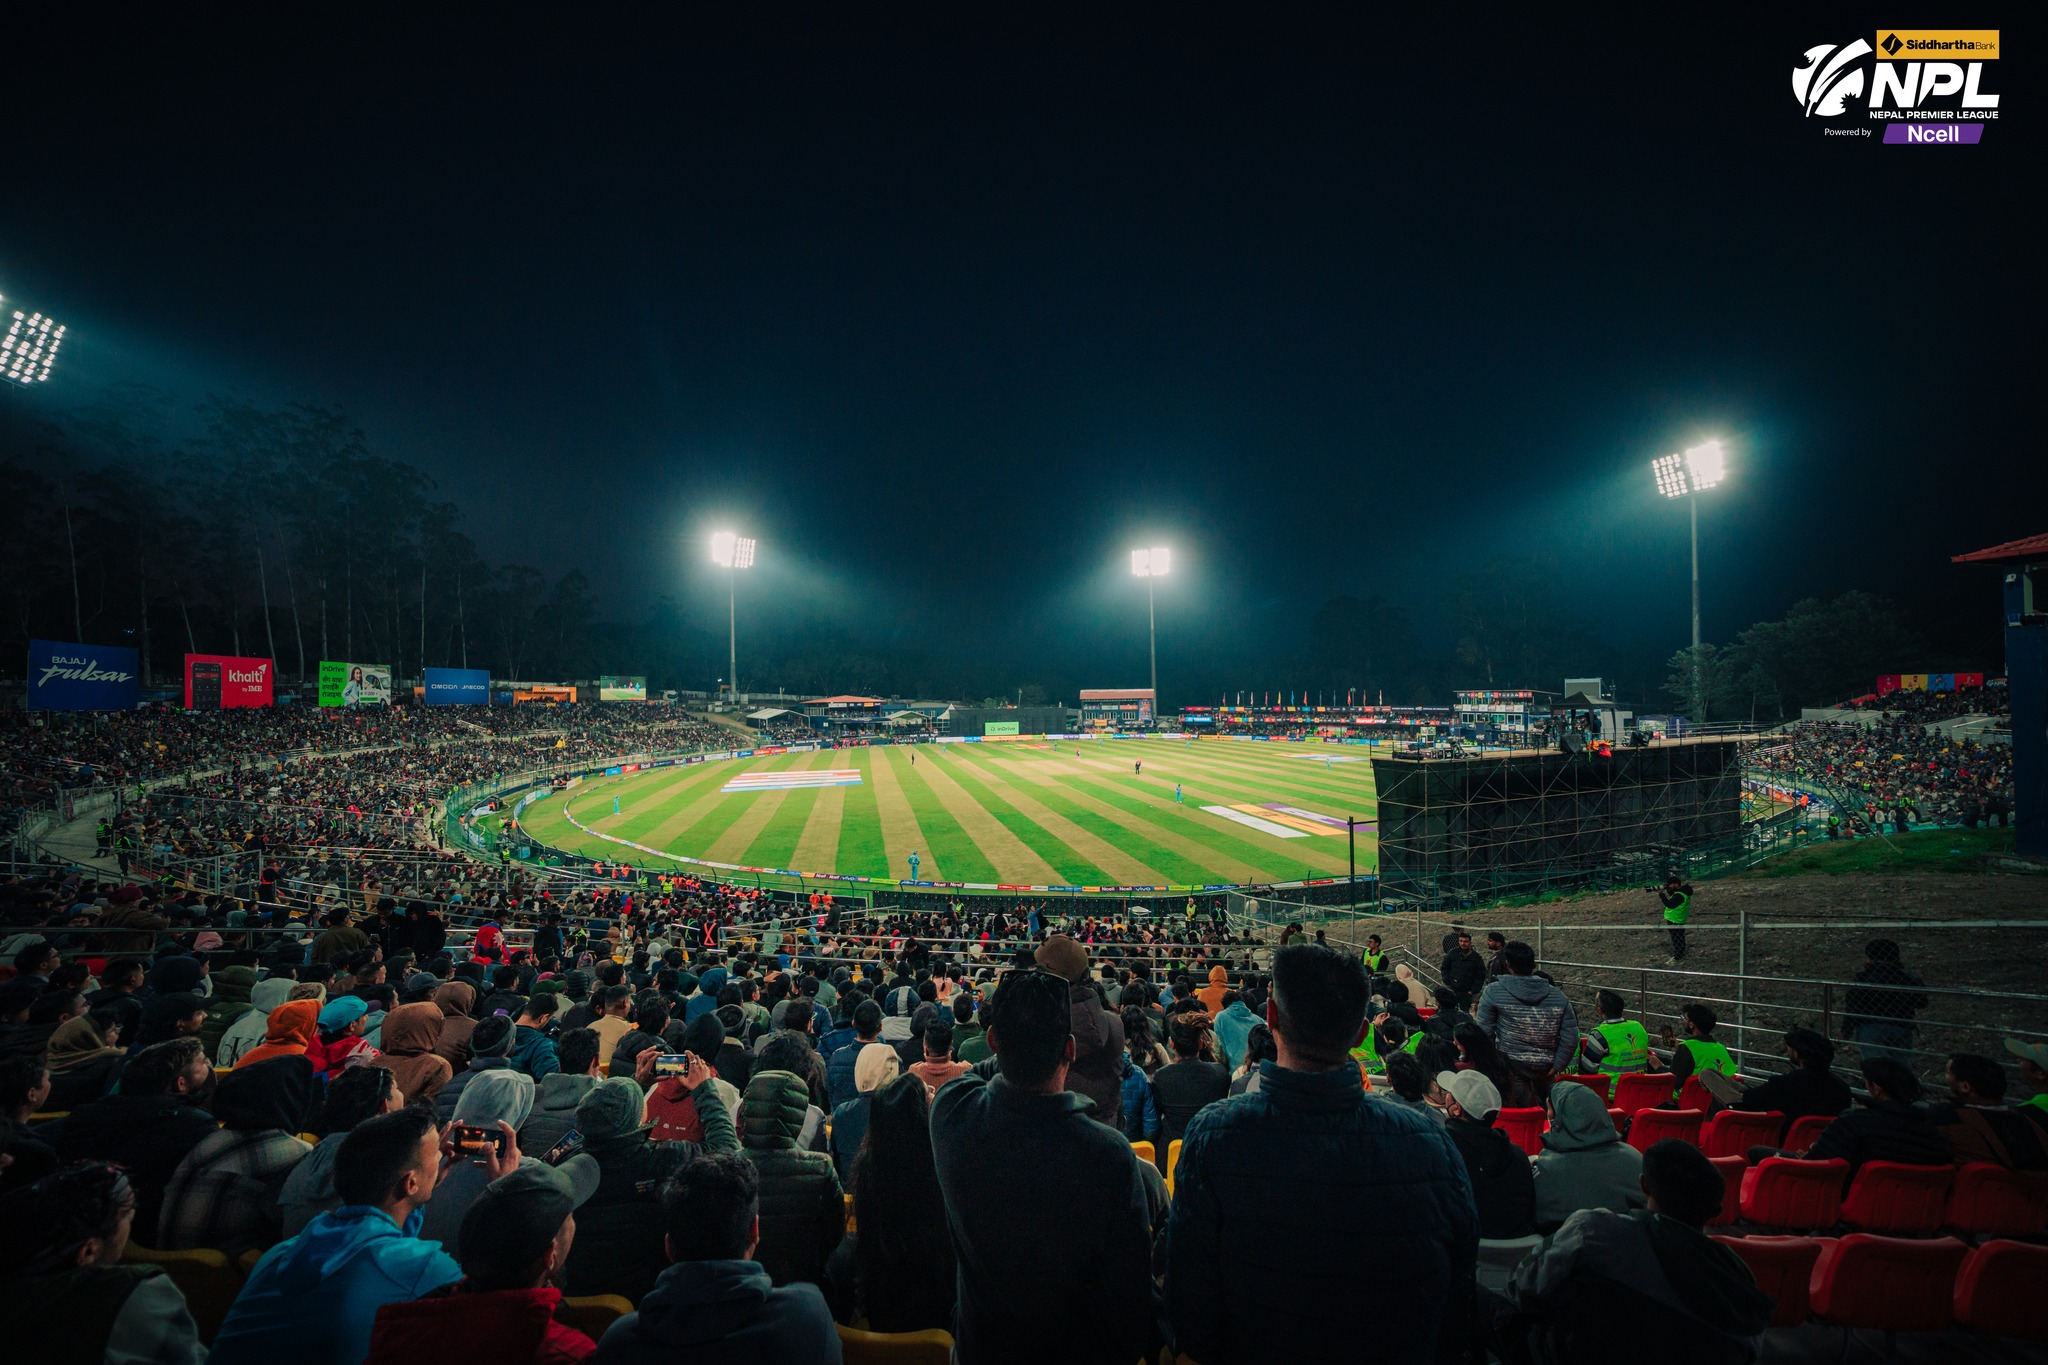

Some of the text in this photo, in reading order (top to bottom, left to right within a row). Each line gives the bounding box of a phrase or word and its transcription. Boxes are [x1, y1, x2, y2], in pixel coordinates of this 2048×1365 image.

[52, 656, 86, 665] BAJAJ
[38, 659, 134, 688] pulsar
[229, 669, 263, 683] khalti
